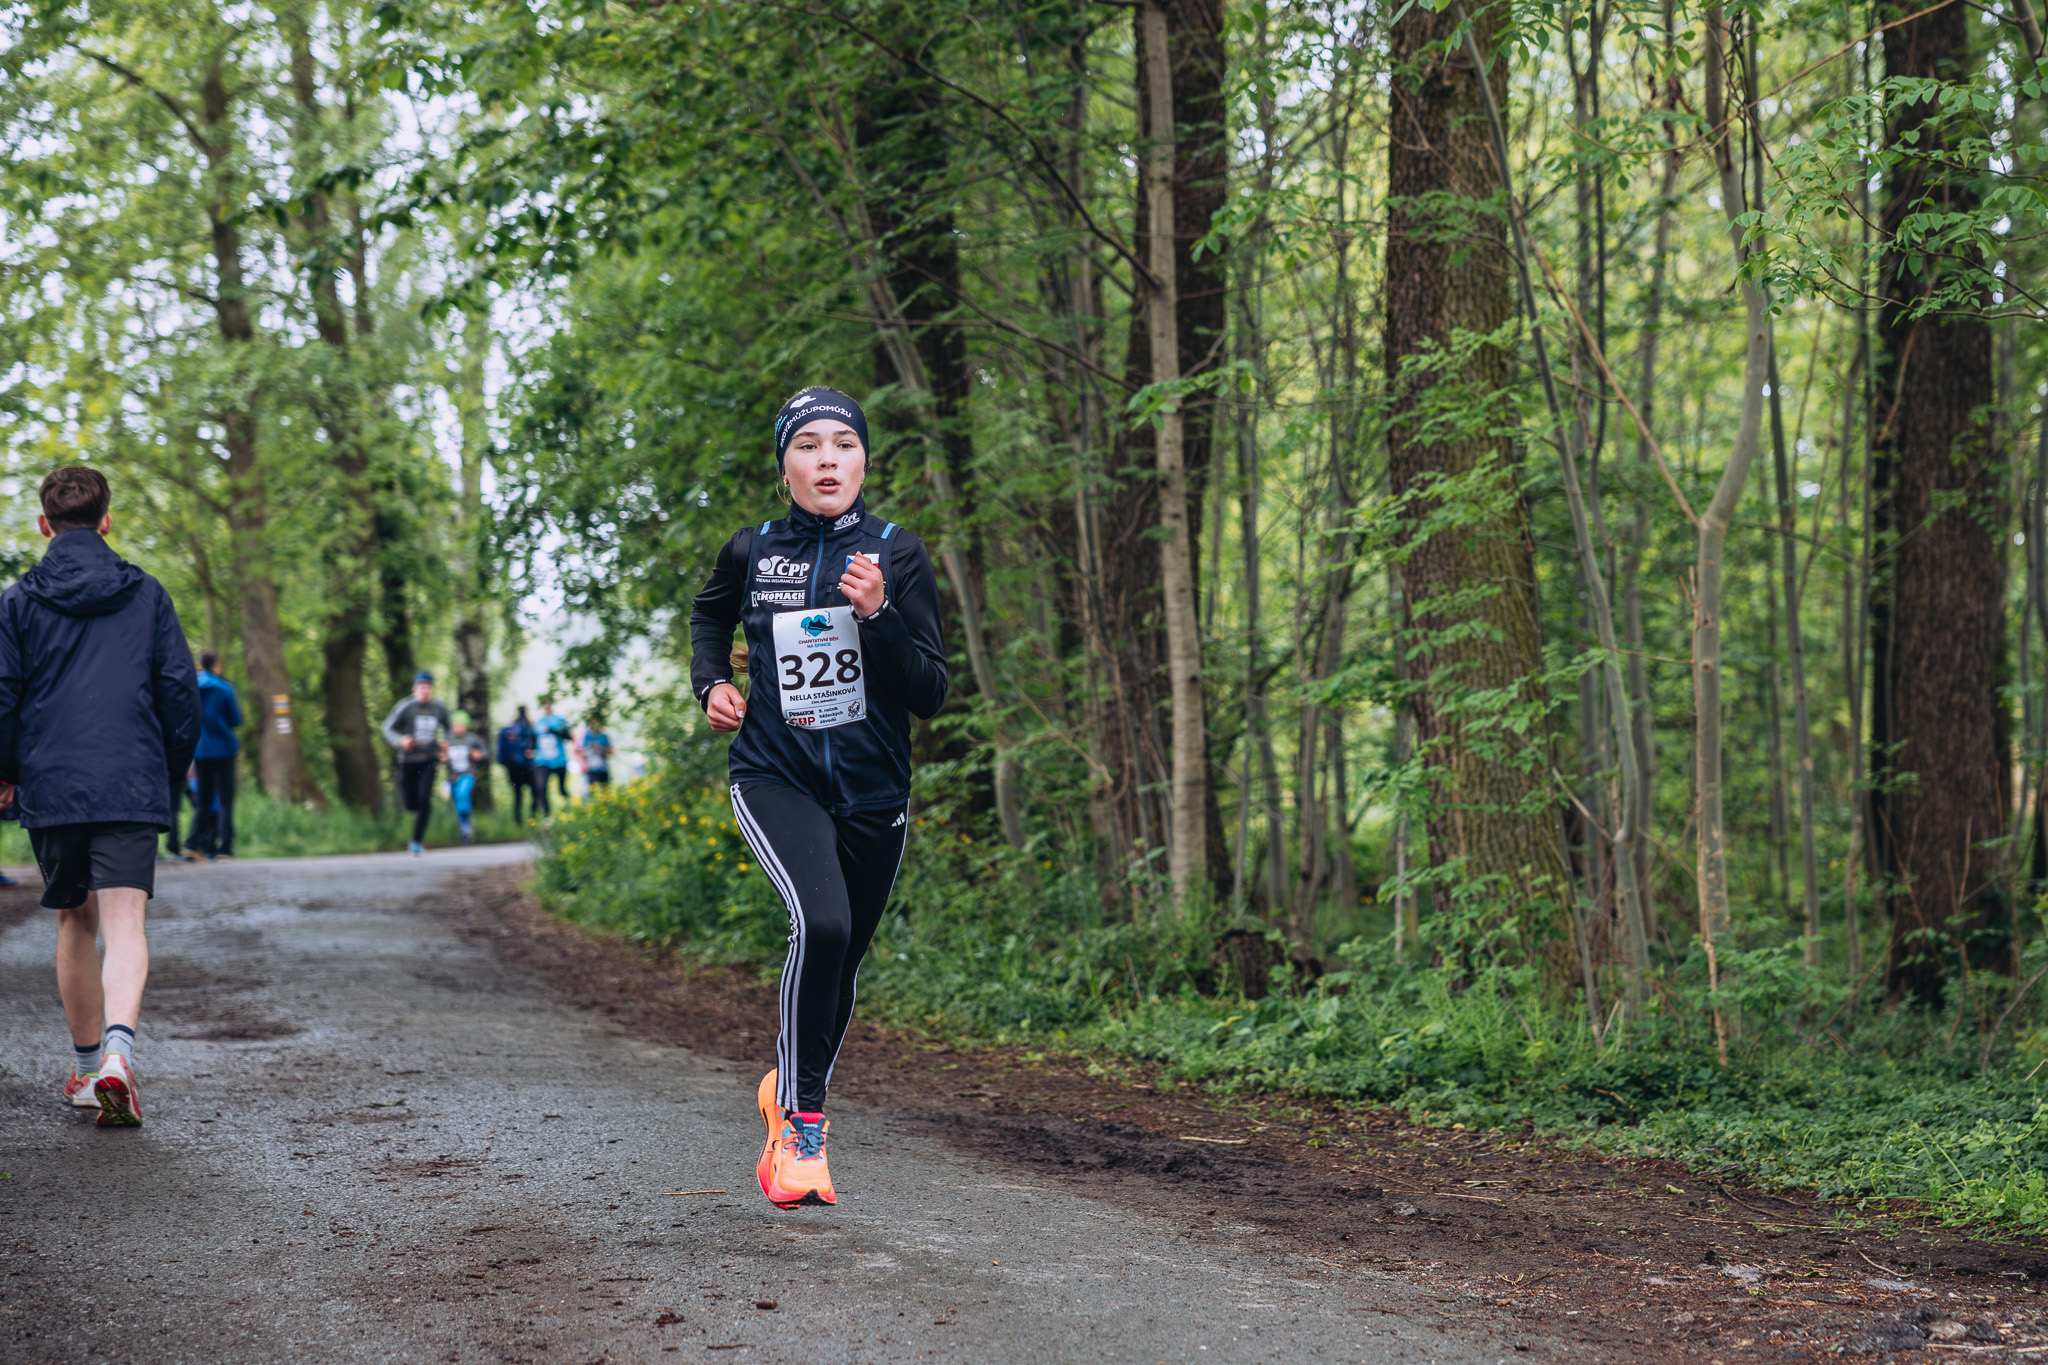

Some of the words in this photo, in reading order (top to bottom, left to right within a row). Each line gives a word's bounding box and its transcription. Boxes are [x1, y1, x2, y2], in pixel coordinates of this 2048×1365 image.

[777, 559, 810, 576] ČPP
[779, 649, 861, 690] 328
[813, 686, 856, 699] STAŠINKOVÁ
